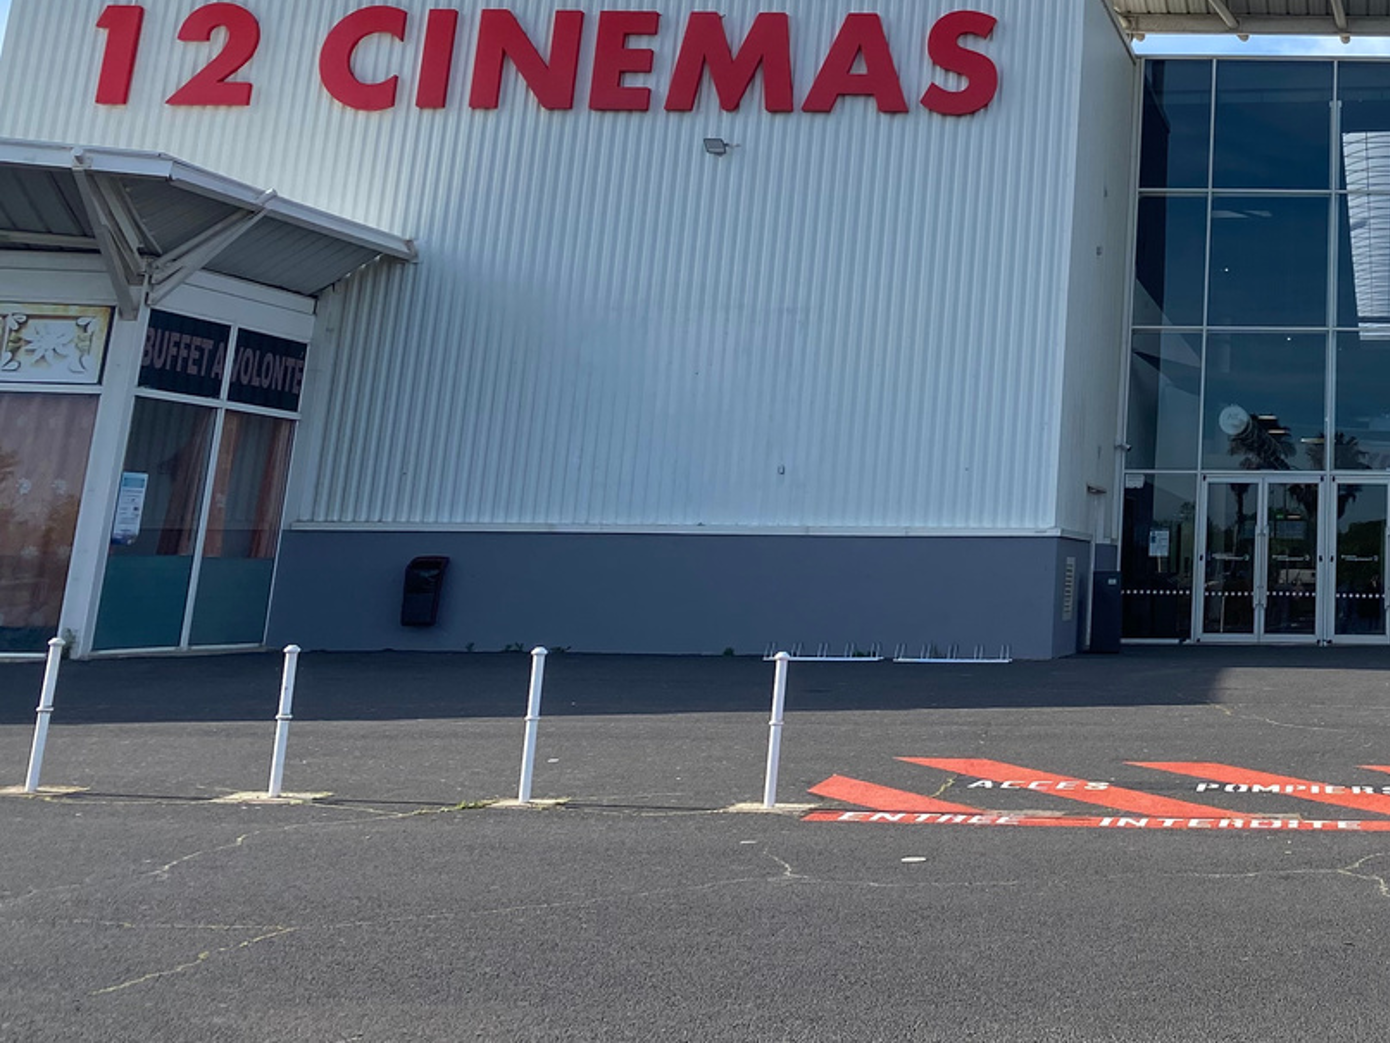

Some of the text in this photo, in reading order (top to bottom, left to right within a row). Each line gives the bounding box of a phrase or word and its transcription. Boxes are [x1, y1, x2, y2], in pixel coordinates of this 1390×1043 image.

[95, 2, 998, 115] 12 CINEMAS
[141, 326, 214, 377] BUFFET
[967, 779, 1110, 791] ACCES
[1098, 817, 1362, 831] INTERDITE
